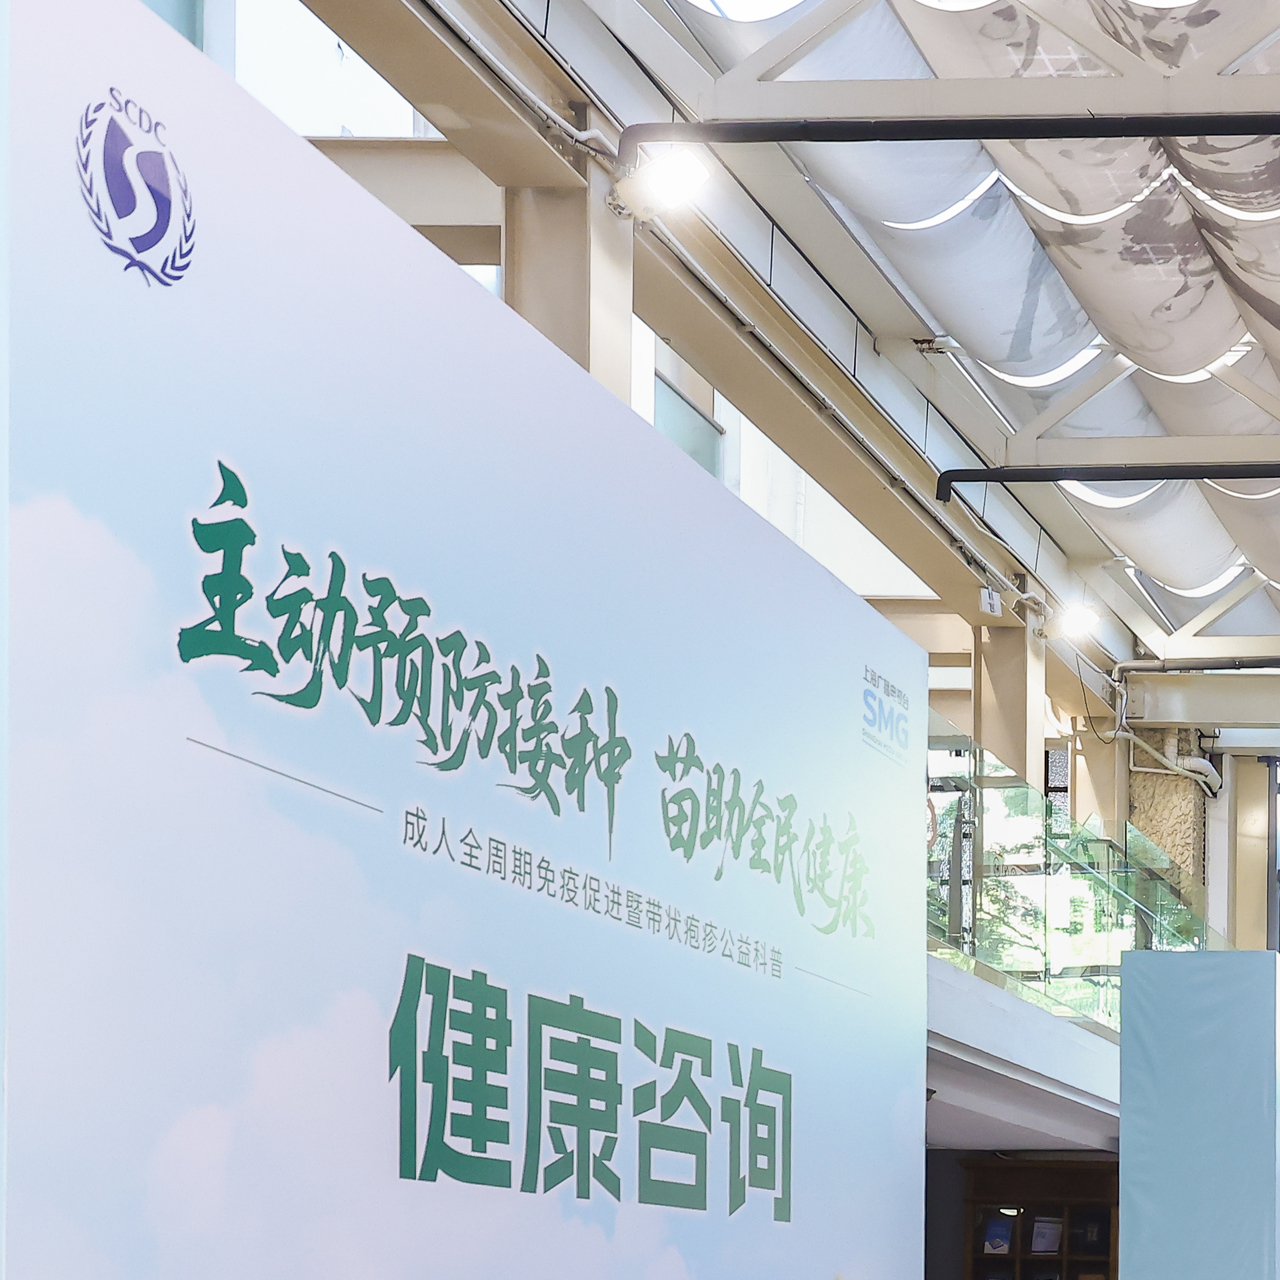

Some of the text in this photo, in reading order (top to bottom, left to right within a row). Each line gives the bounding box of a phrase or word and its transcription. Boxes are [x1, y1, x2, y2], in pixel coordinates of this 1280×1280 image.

[108, 86, 167, 147] SCDC
[178, 460, 876, 940] 主动预防接种 苗助全民健康
[863, 688, 909, 750] SMG
[402, 807, 784, 979] 成人全周期免疫促进暨带状疱疹公益科普
[389, 953, 792, 1223] 健康咨询
